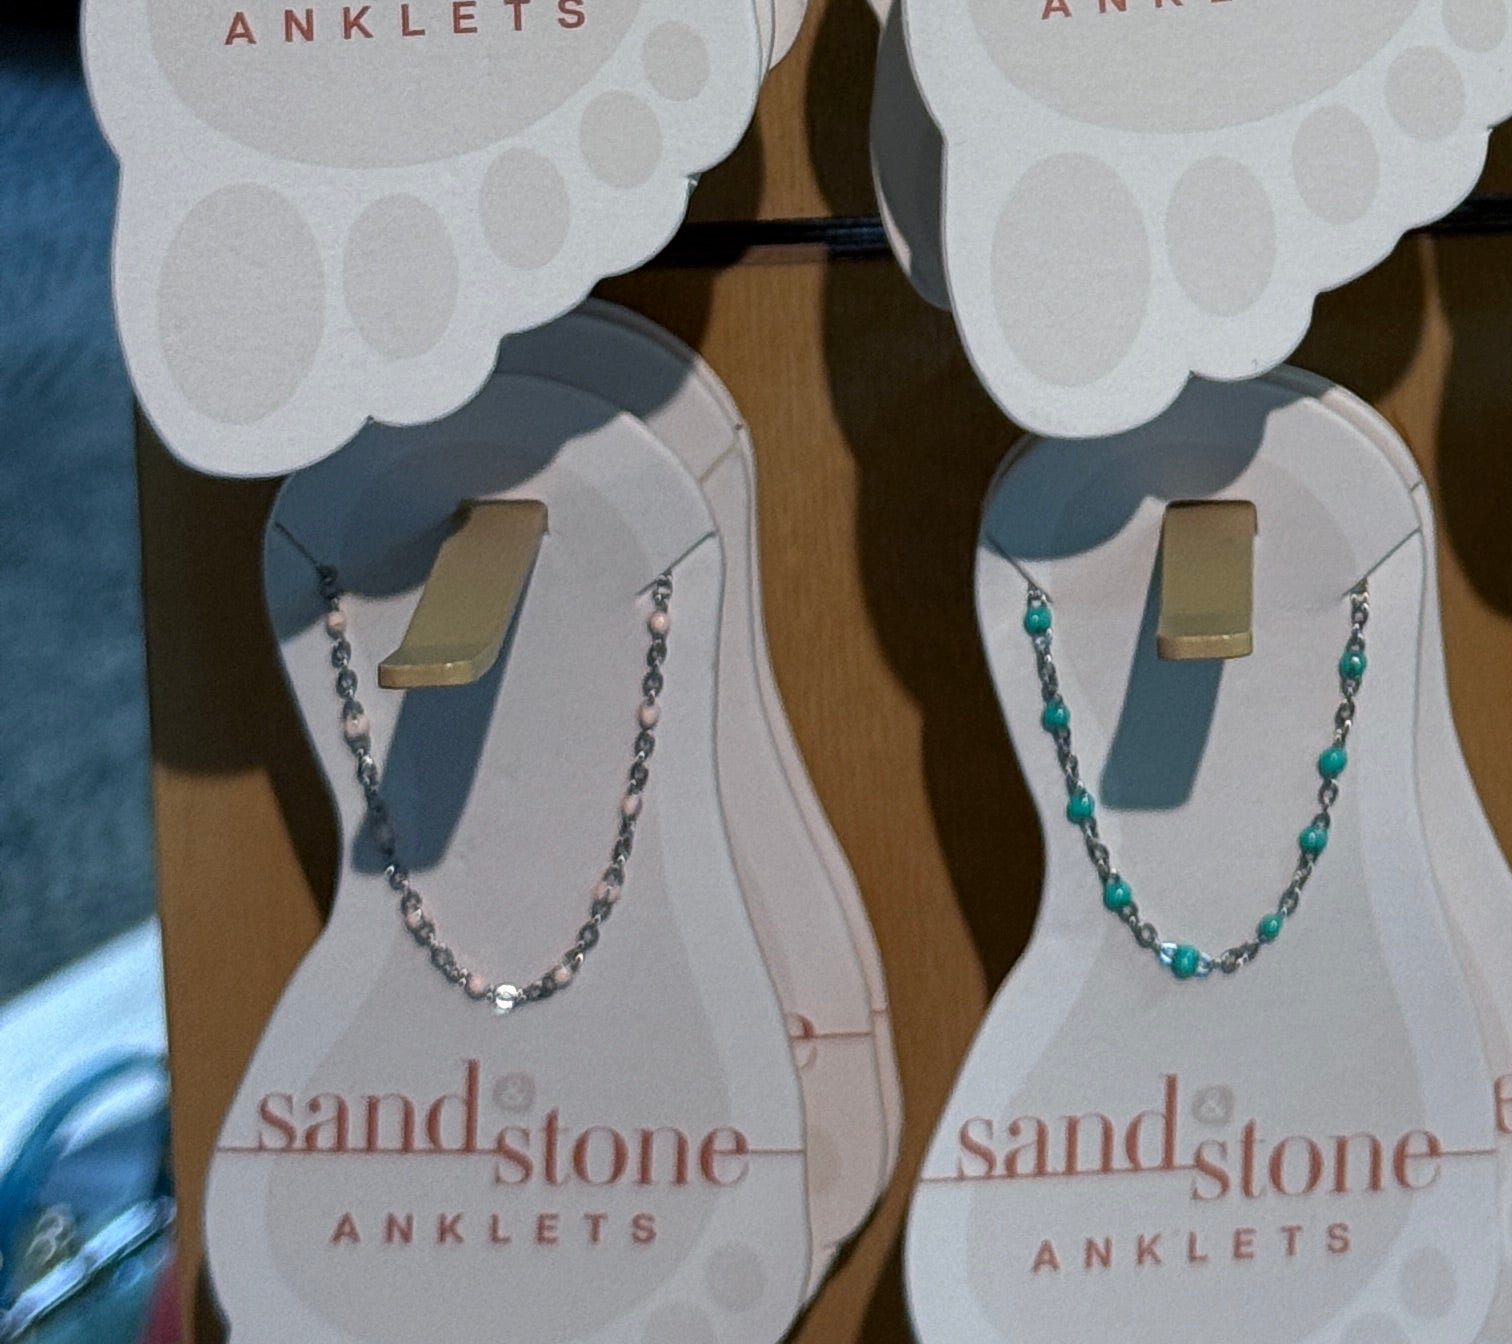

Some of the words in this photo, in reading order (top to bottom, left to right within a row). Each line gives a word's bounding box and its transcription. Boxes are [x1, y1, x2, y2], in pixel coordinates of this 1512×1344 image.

[257, 1058, 479, 1154] sand
[494, 1107, 750, 1188] stone
[958, 1073, 1178, 1179] sand
[1191, 1118, 1442, 1201] stone
[330, 1212, 657, 1246] ANKLETS
[1030, 1223, 1352, 1274] ANKLETS
